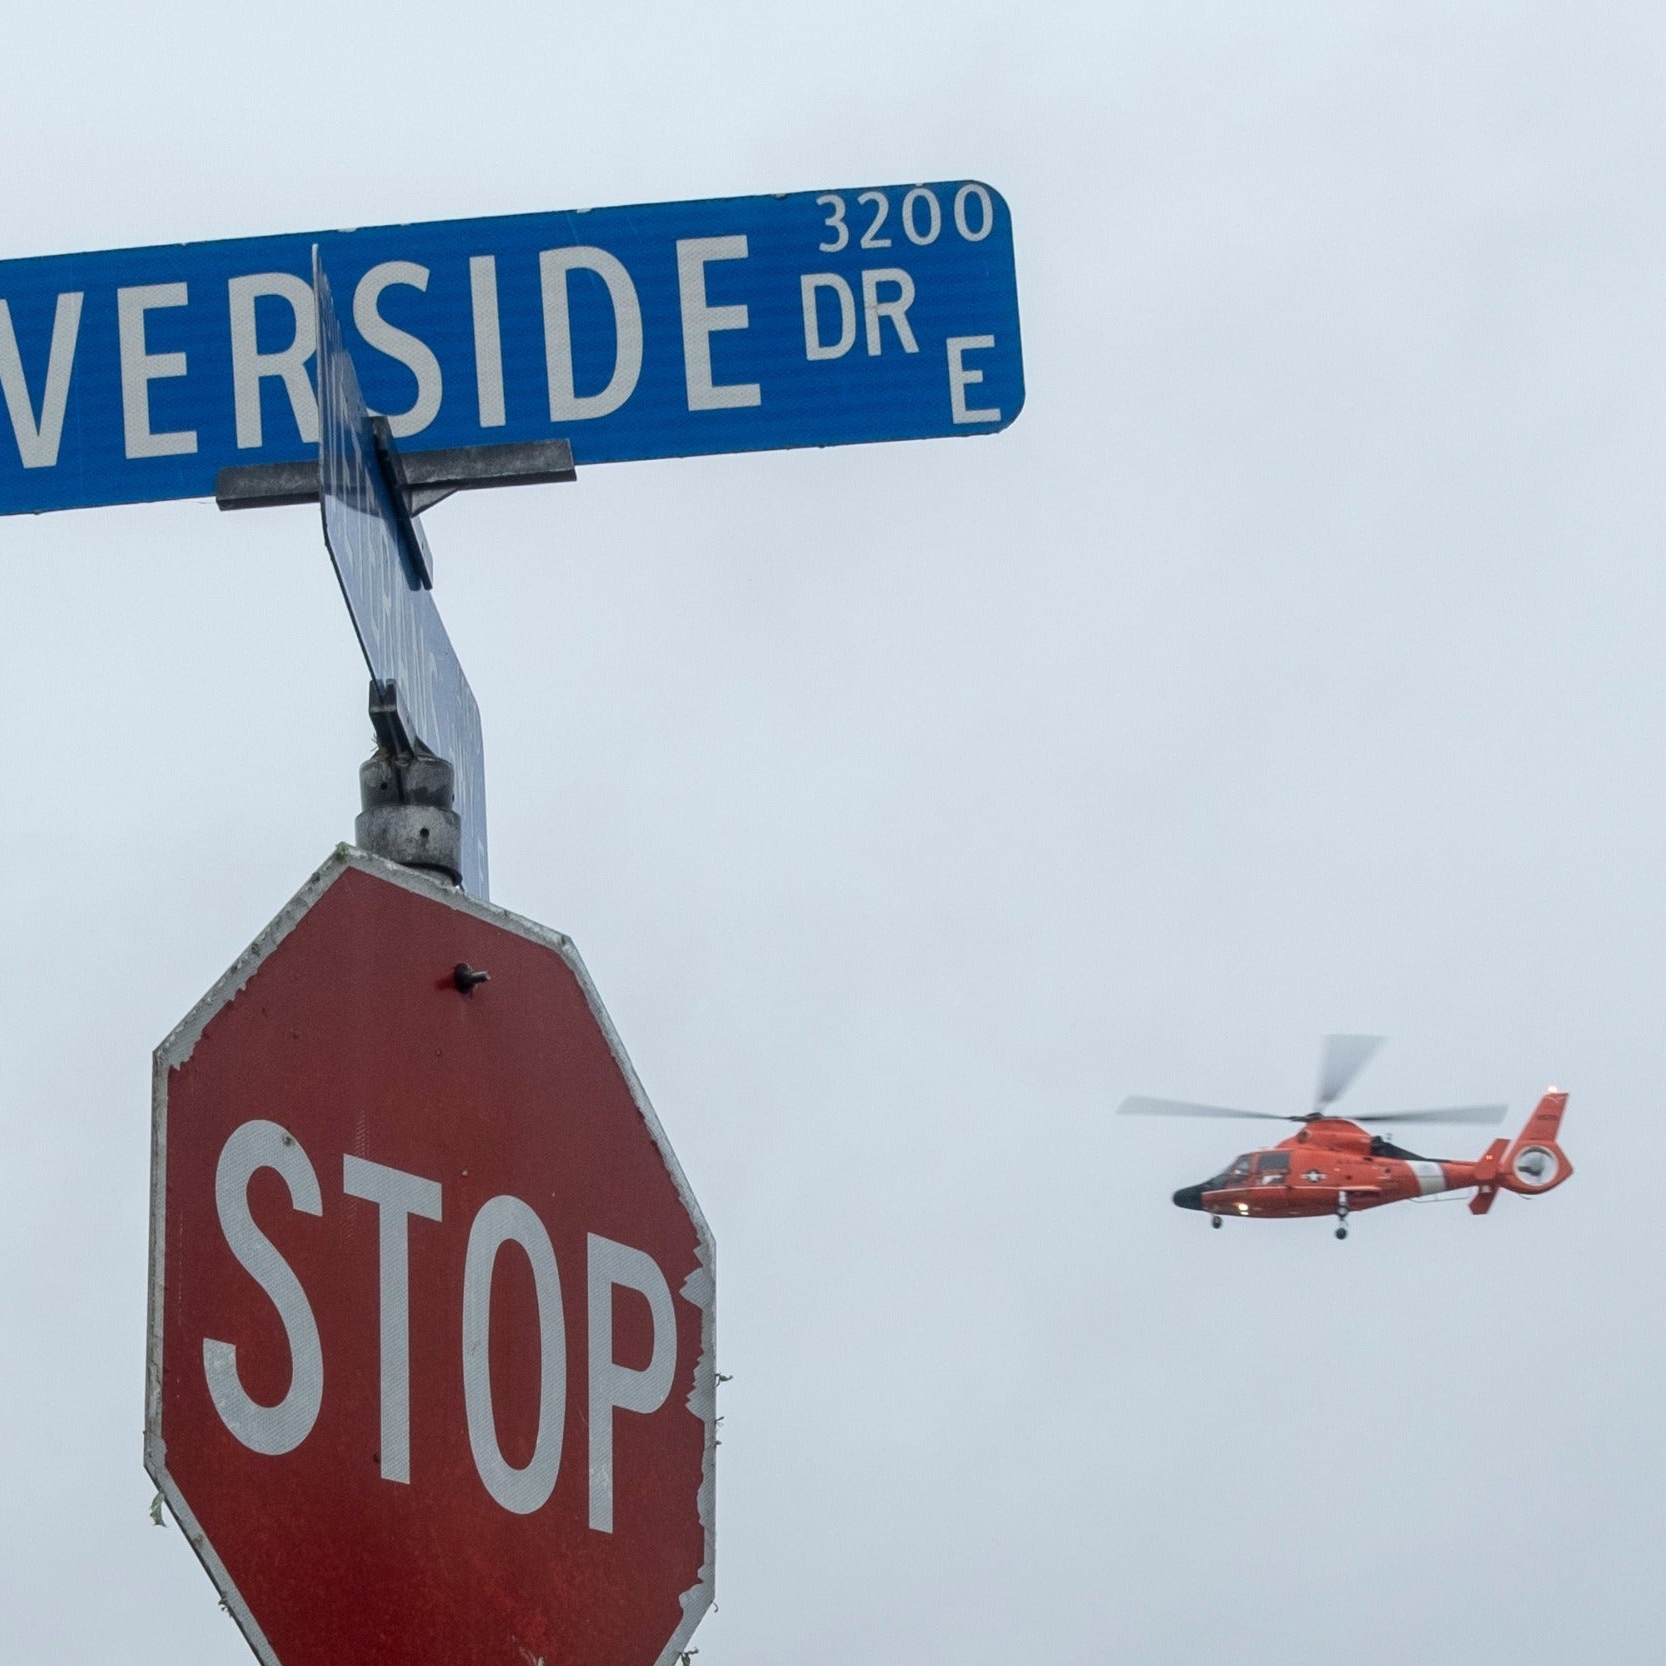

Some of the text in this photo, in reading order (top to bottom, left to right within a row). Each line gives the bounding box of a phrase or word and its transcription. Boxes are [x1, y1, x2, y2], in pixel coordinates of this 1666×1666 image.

[816, 184, 994, 253] 3200
[800, 268, 920, 361] DR
[946, 334, 1002, 424] E
[202, 1119, 678, 1535] STOP
